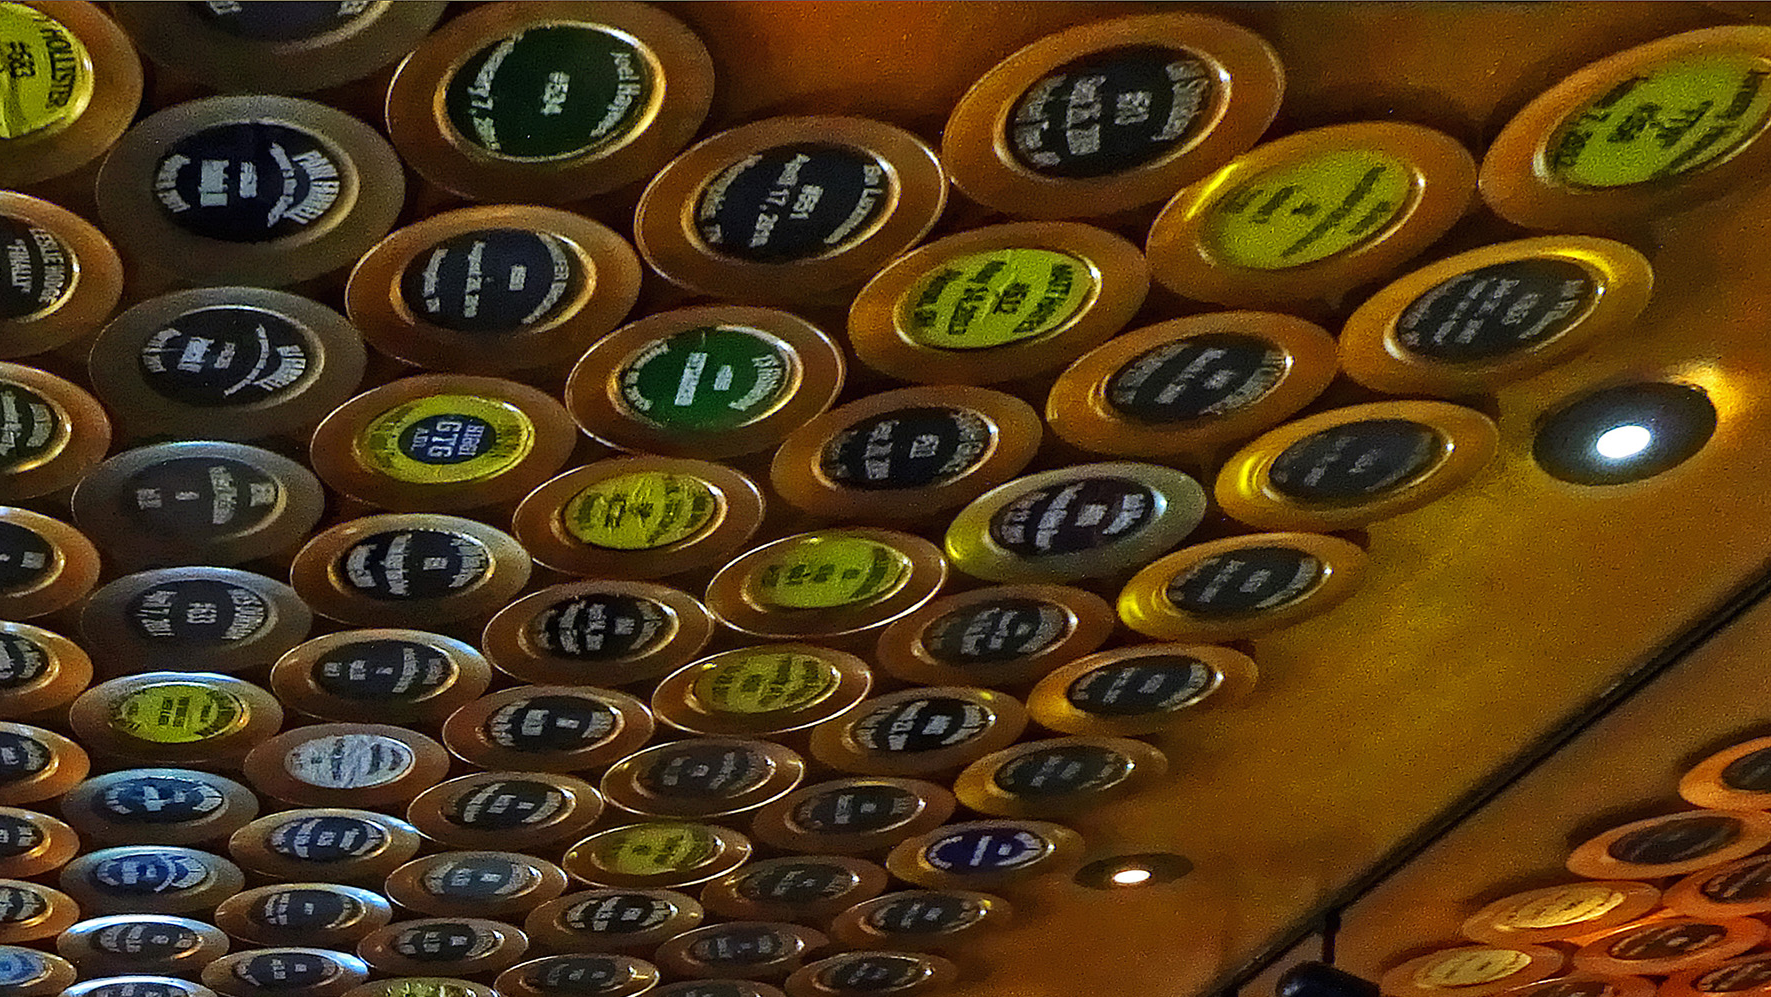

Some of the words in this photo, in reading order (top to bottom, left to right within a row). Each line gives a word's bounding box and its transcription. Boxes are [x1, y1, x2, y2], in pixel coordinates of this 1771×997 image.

[40, 29, 76, 109] HOLLISTER
[28, 228, 61, 263] LESLIE
[38, 264, 65, 303] HODGE
[427, 421, 463, 457] GTG
[186, 602, 217, 624] #633
